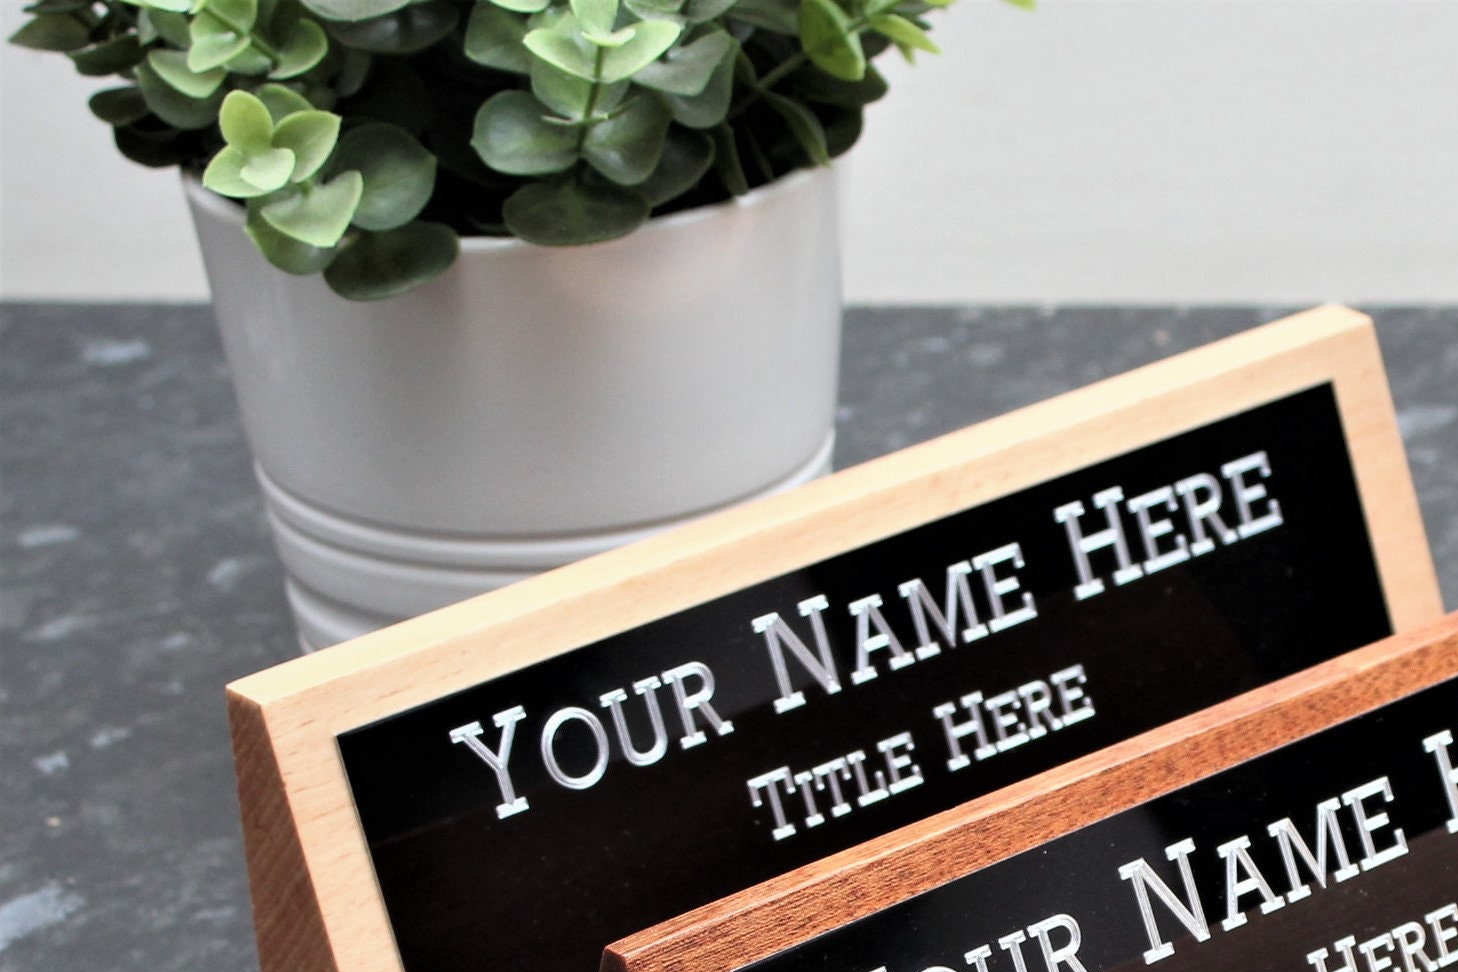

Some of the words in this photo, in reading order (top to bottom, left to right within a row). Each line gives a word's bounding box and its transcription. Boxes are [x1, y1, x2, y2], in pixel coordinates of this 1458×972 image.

[449, 661, 735, 819] YOUR
[751, 543, 1038, 715] NAME
[1053, 450, 1284, 601] HERE
[747, 732, 923, 842] TITLE
[933, 663, 1096, 771] HERE
[1118, 776, 1409, 965] NAME
